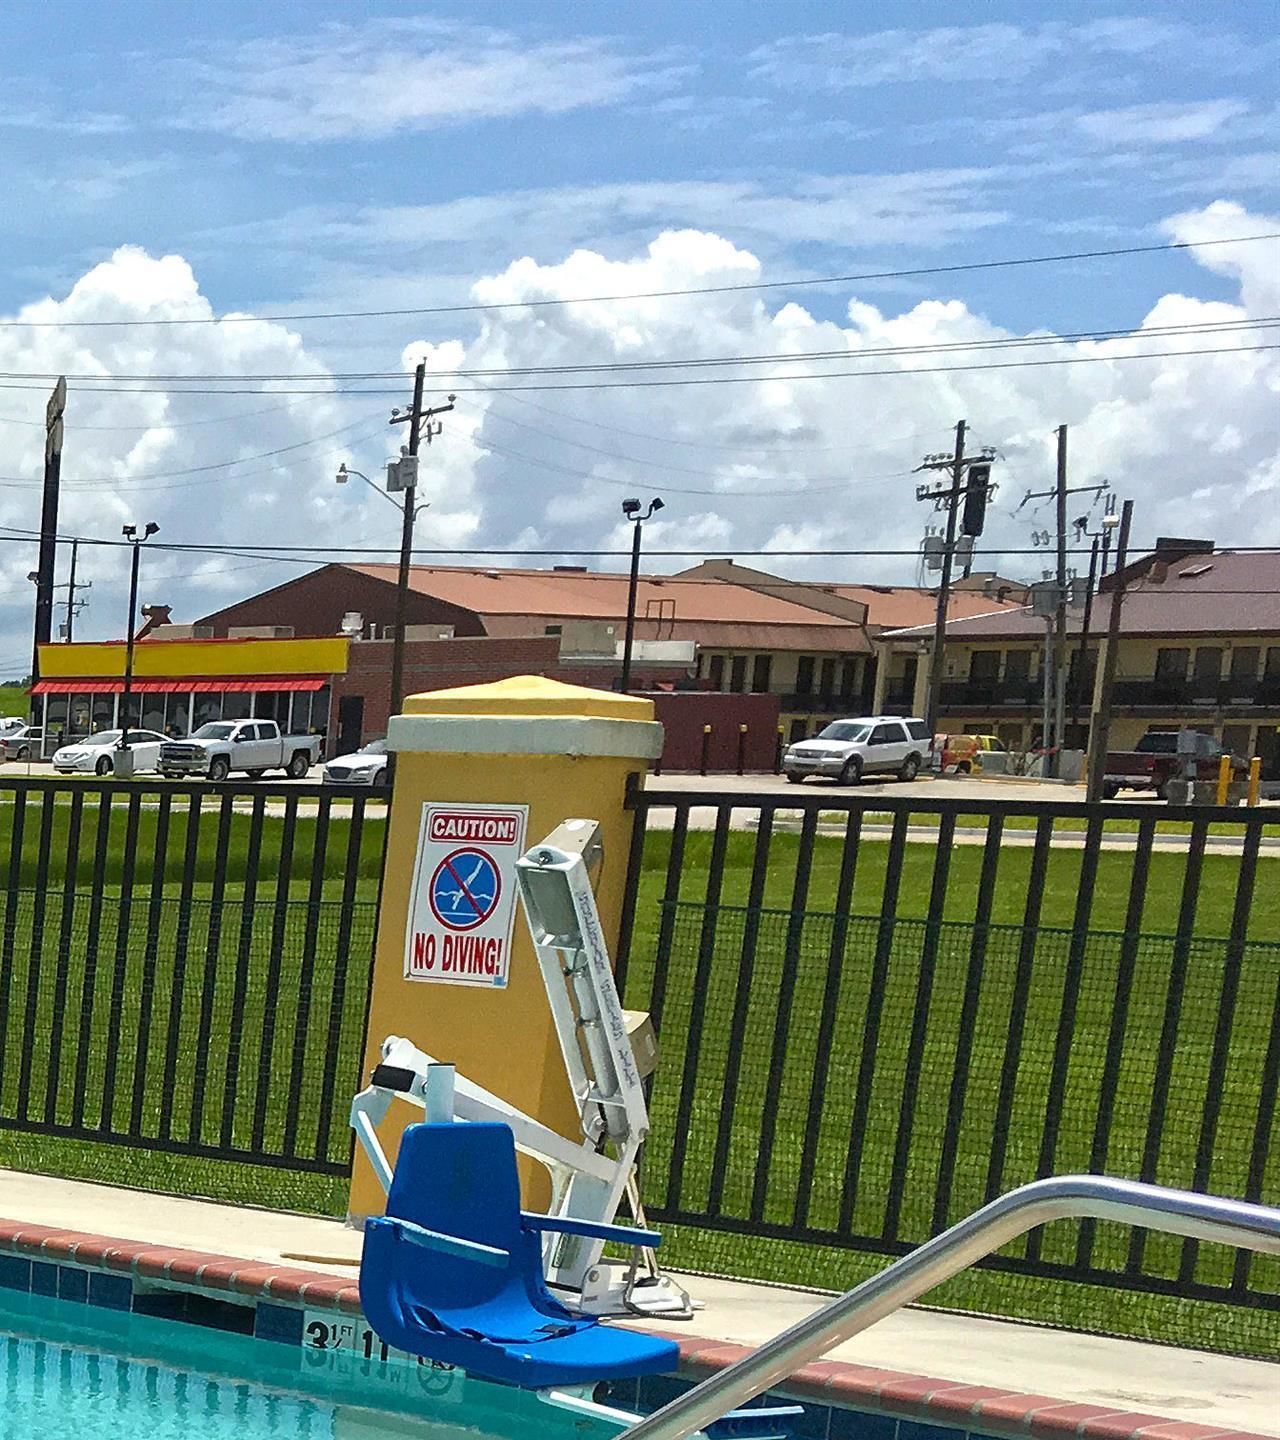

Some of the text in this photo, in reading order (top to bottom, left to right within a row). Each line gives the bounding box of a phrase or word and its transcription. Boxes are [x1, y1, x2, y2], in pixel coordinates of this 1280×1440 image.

[433, 818, 515, 838] CAUTION!
[414, 933, 503, 975] NO DIVING!
